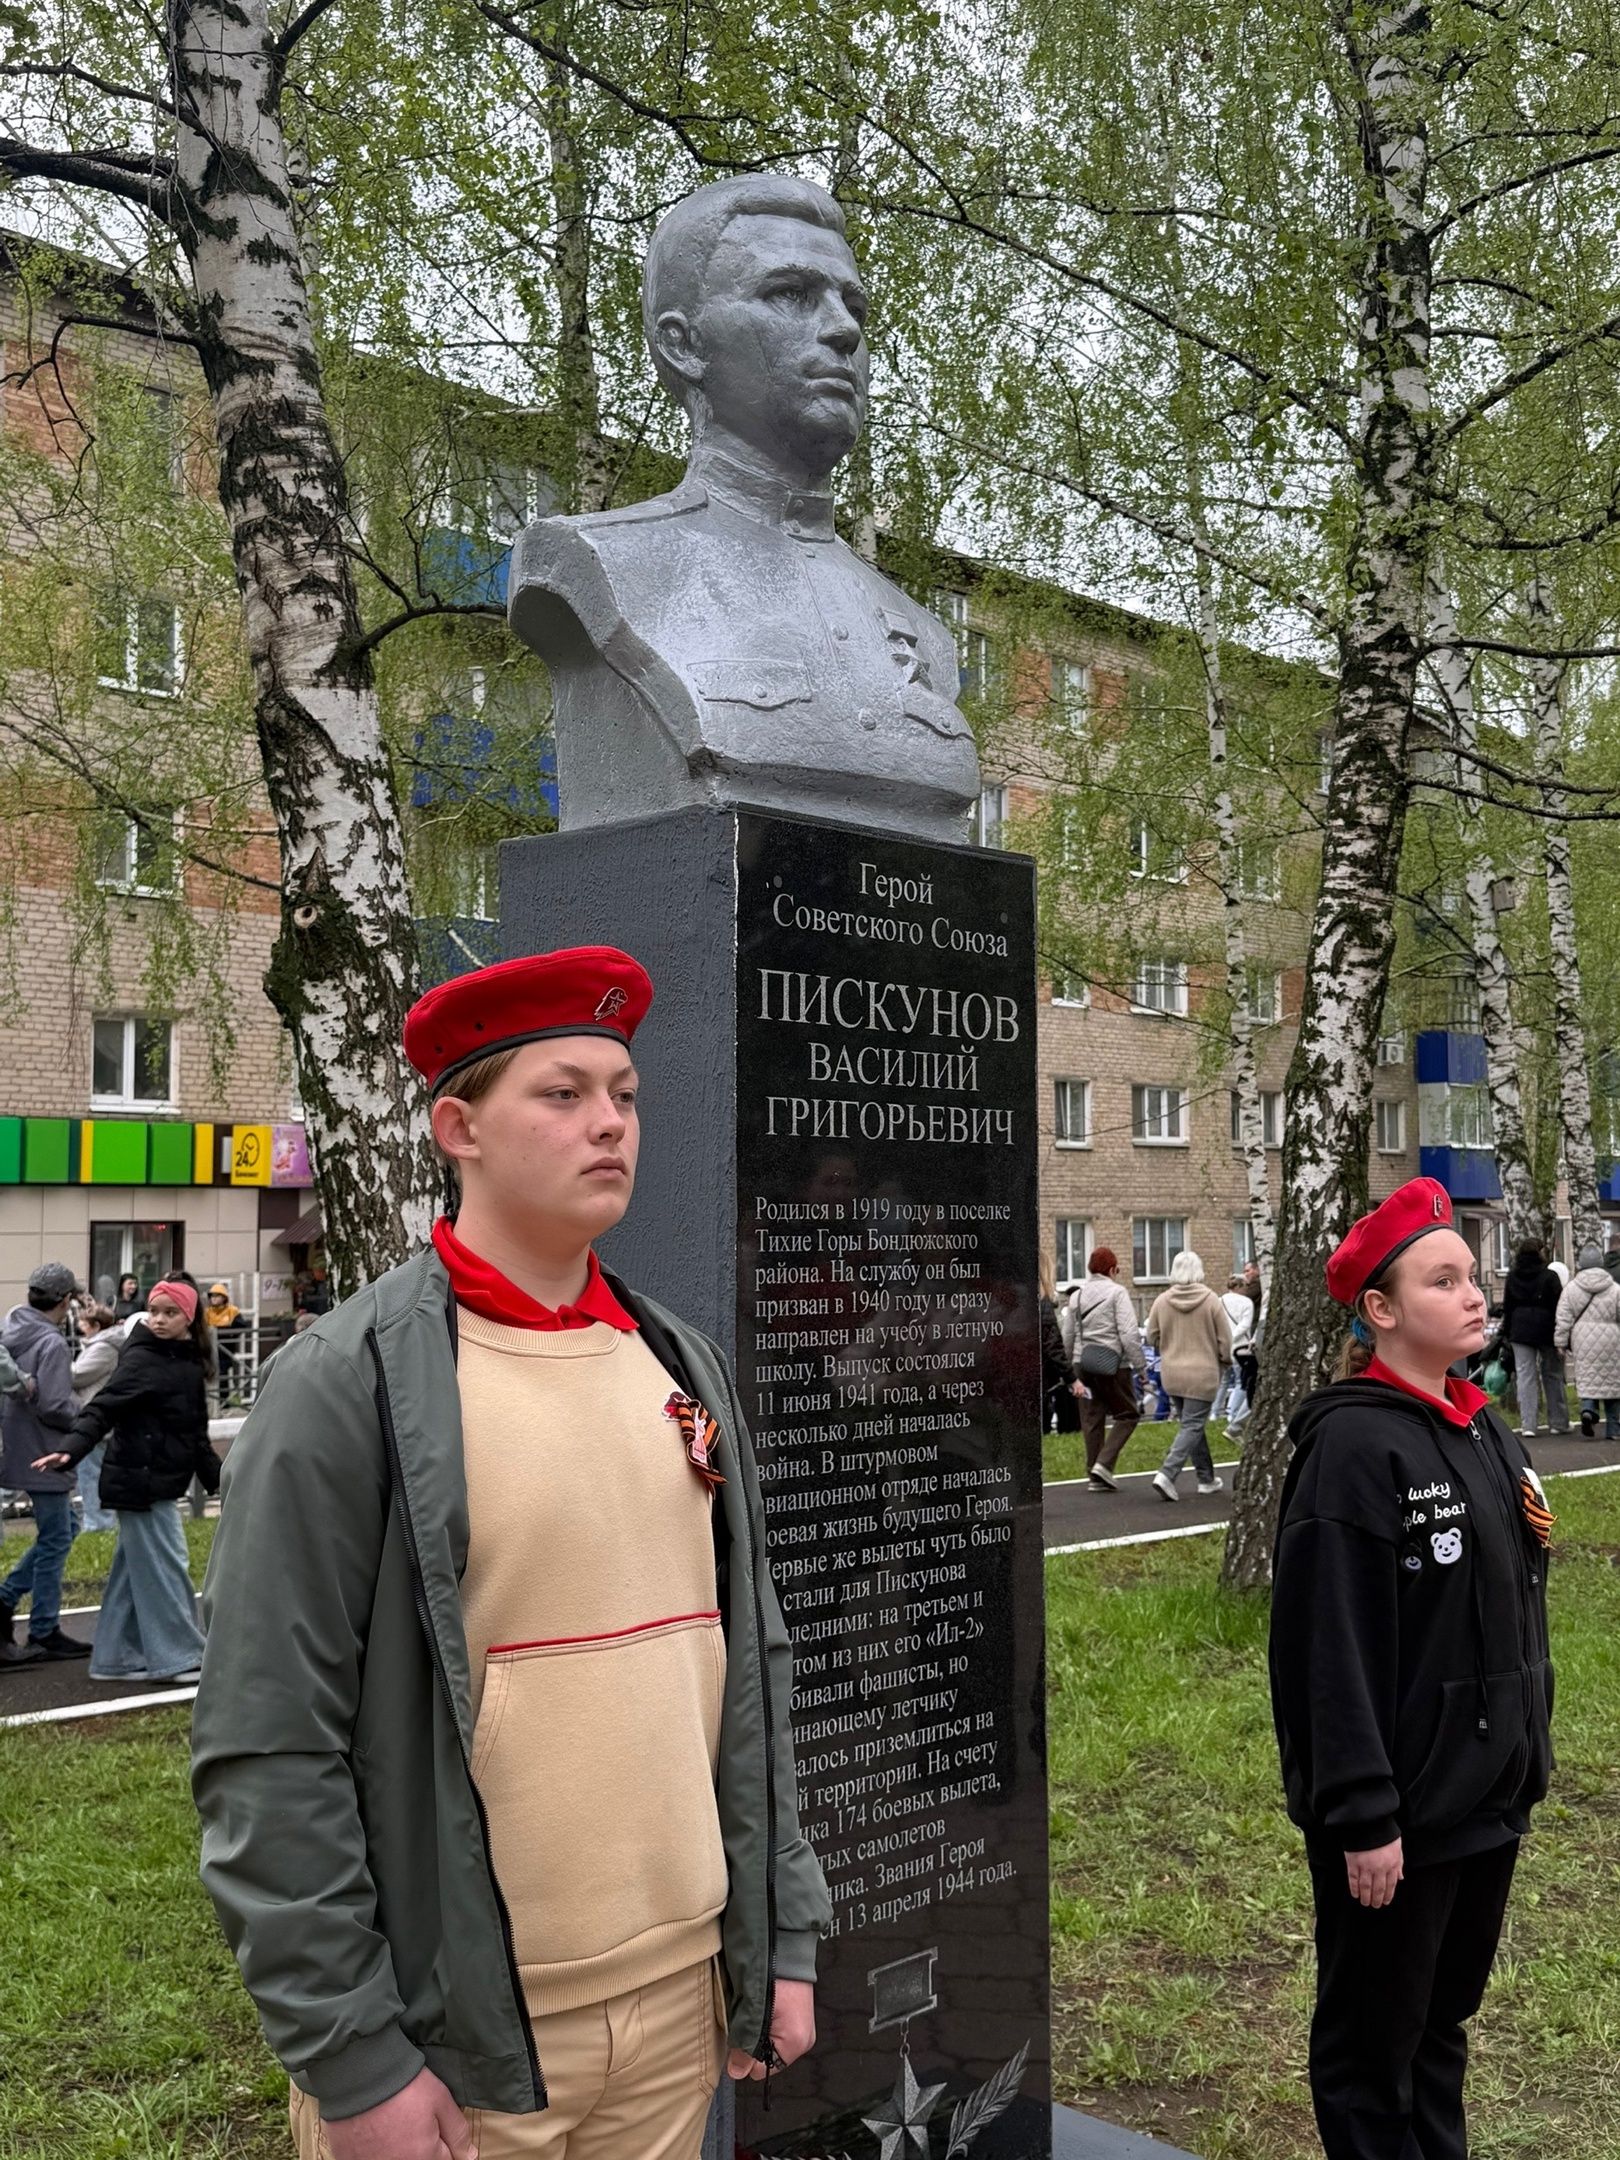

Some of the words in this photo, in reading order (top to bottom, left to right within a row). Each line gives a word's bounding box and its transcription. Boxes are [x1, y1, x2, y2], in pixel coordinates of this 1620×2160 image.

[859, 862, 933, 908] Герой
[773, 893, 923, 945] Советского
[931, 917, 1008, 957] Союза
[757, 968, 1019, 1042] ПИСКУНОВ
[808, 1042, 979, 1091] ВАСИЛИЙ
[766, 1096, 1014, 1145] ГРИГОРЬЕВИЧ
[756, 1197, 829, 1222] Родился
[836, 1204, 844, 1219] в
[853, 1198, 890, 1219] 1919
[896, 1205, 931, 1226] году
[936, 1205, 944, 1220] в
[950, 1205, 1010, 1220] поселке
[755, 1229, 811, 1252] Тихие
[817, 1229, 862, 1258] Горы
[868, 1228, 978, 1252] Бондюжского
[755, 1262, 824, 1291] района.
[831, 1260, 854, 1282] На
[859, 1258, 920, 1287] службу
[925, 1264, 944, 1279] он
[950, 1257, 980, 1279] был
[756, 1298, 829, 1323] призван
[835, 1298, 844, 1313] в
[852, 1289, 890, 1313] 1940
[895, 1295, 931, 1316] году
[936, 1294, 945, 1309] и
[951, 1293, 991, 1315] сразу
[756, 1329, 849, 1355] направлен
[855, 1327, 874, 1344] на
[880, 1319, 927, 1349] учебу
[933, 1324, 941, 1339] в
[946, 1321, 1003, 1342] летную
[756, 1363, 816, 1386] школу.
[823, 1355, 890, 1381] Выпуск
[896, 1352, 974, 1372] состоялся
[758, 1392, 773, 1415] 11
[783, 1393, 831, 1413] июня
[839, 1383, 875, 1408] 1941
[883, 1386, 923, 1405] года,
[928, 1385, 936, 1400] а
[942, 1381, 984, 1404] через
[756, 1424, 847, 1449] несколько
[852, 1414, 893, 1441] дней
[899, 1412, 970, 1434] началась
[756, 1456, 815, 1482] война.
[821, 1450, 834, 1474] В
[841, 1445, 938, 1475] штурмовом
[764, 1484, 876, 1514] виационном
[881, 1476, 938, 1502] отряде
[943, 1467, 1011, 1490] началась
[1434, 1501, 1466, 1519] bear
[766, 1524, 817, 1547] оевая
[823, 1516, 878, 1538] жизнь
[883, 1504, 961, 1534] будущего
[966, 1494, 1013, 1520] Героя.
[832, 1550, 856, 1570] же
[862, 1539, 925, 1565] вылеты
[931, 1533, 966, 1558] чуть
[971, 1524, 1011, 1546] было
[783, 1586, 835, 1611] стали
[840, 1580, 870, 1604] для
[877, 1563, 966, 1594] Пискунова
[879, 1607, 898, 1626] на
[904, 1594, 968, 1626] третьем
[974, 1591, 983, 1607] и
[833, 1649, 852, 1668] из
[858, 1641, 889, 1662] них
[895, 1634, 921, 1654] его
[926, 1617, 984, 1646] «Ил-2»
[860, 1662, 943, 1701] фашисты,
[949, 1656, 968, 1674] но
[891, 1688, 958, 1720] летчику
[855, 1717, 970, 1766] приземлиться
[976, 1711, 994, 1730] на
[815, 1763, 921, 1808] территории.
[927, 1749, 950, 1775] На
[955, 1741, 997, 1767] счету
[838, 1803, 867, 1834] 174
[873, 1790, 935, 1823] боевых
[941, 1773, 1000, 1803] вылета,
[857, 1819, 945, 1860] самолетов
[875, 1854, 933, 1888] Звания
[940, 1838, 984, 1868] Героя
[849, 1903, 866, 1931] 13
[873, 1888, 930, 1922] апреля
[939, 1867, 974, 1900] 1944
[980, 1861, 1016, 1886] года.
